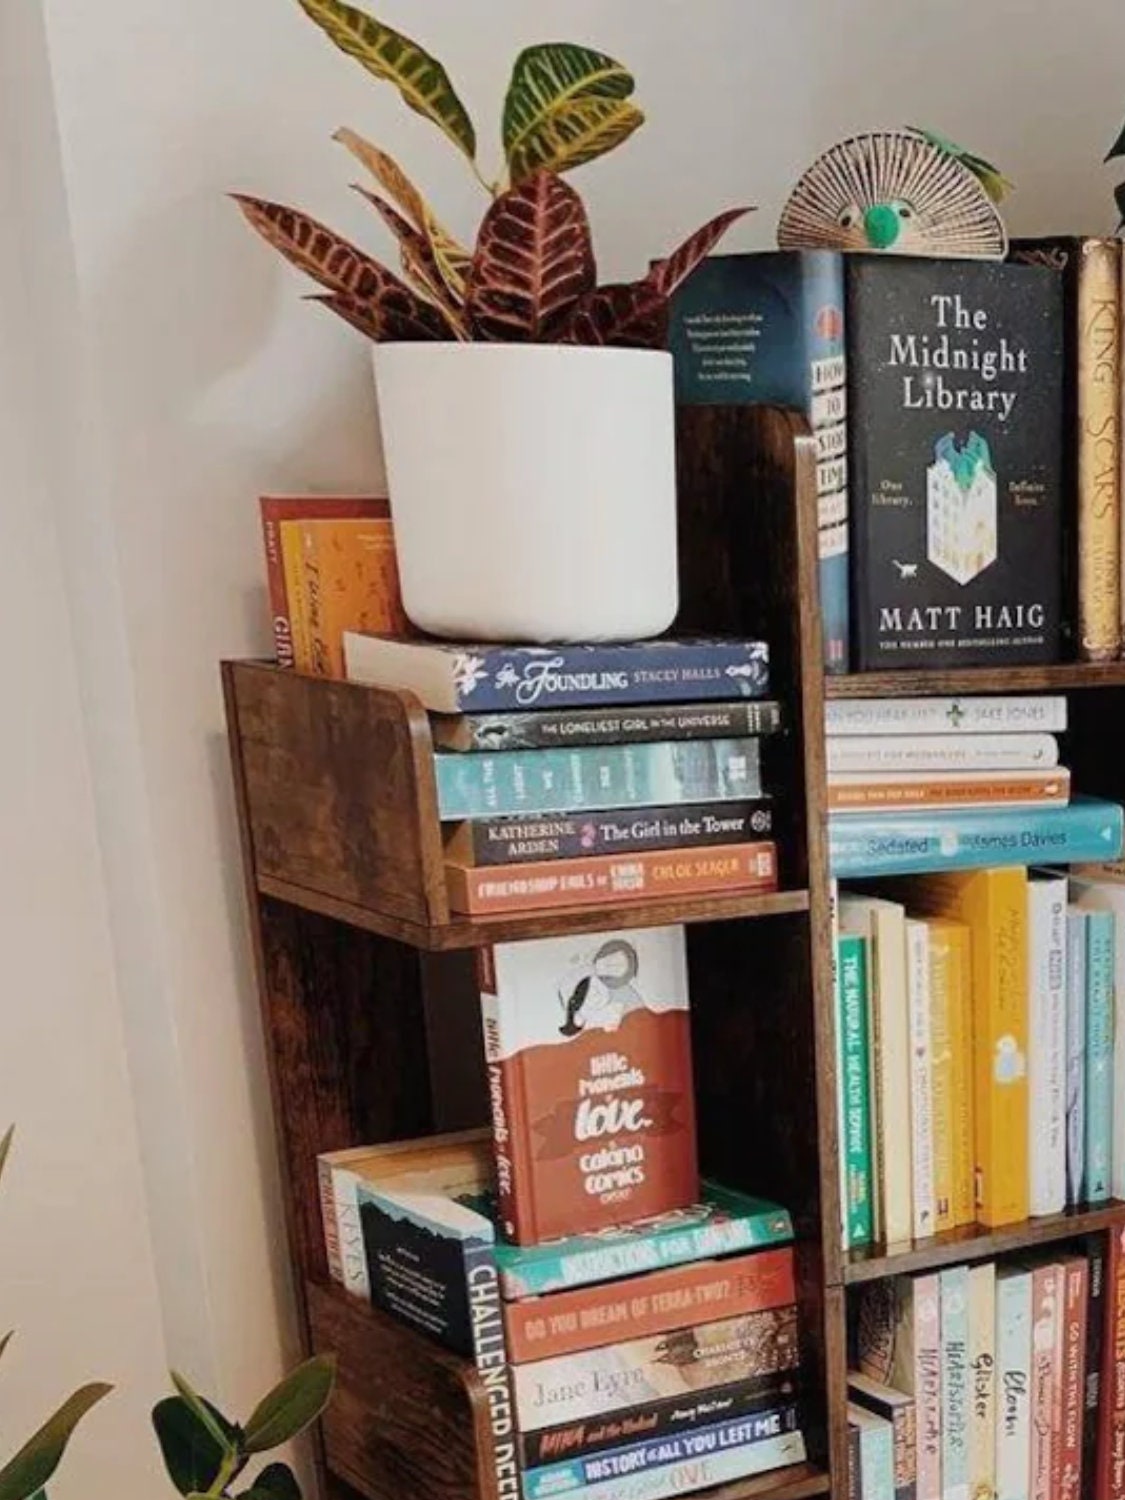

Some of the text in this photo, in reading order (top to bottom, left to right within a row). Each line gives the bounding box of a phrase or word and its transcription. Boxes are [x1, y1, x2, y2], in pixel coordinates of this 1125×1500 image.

[931, 296, 987, 330] The
[888, 338, 1028, 381] Midnight
[903, 375, 1016, 420] Library
[1086, 299, 1118, 519] KING SCARS
[879, 603, 1045, 632] MATT HAIG
[559, 718, 620, 735] LONELIEST
[623, 716, 648, 731] GIRL
[678, 714, 730, 729] UNIVERSE
[487, 821, 576, 841] KATHERINE
[601, 814, 744, 842] The Girl in the Tower
[1020, 831, 1067, 847] Davies
[508, 839, 559, 856] ARDEN
[585, 1166, 646, 1195] comics
[524, 1298, 650, 1339] DO YOU DREAM OF
[468, 1263, 512, 1436] CHALLENGED
[533, 1376, 584, 1408] Jane
[970, 1351, 993, 1419] Glister
[584, 1413, 780, 1480] HISTORY ALL YOU LEFT ME
